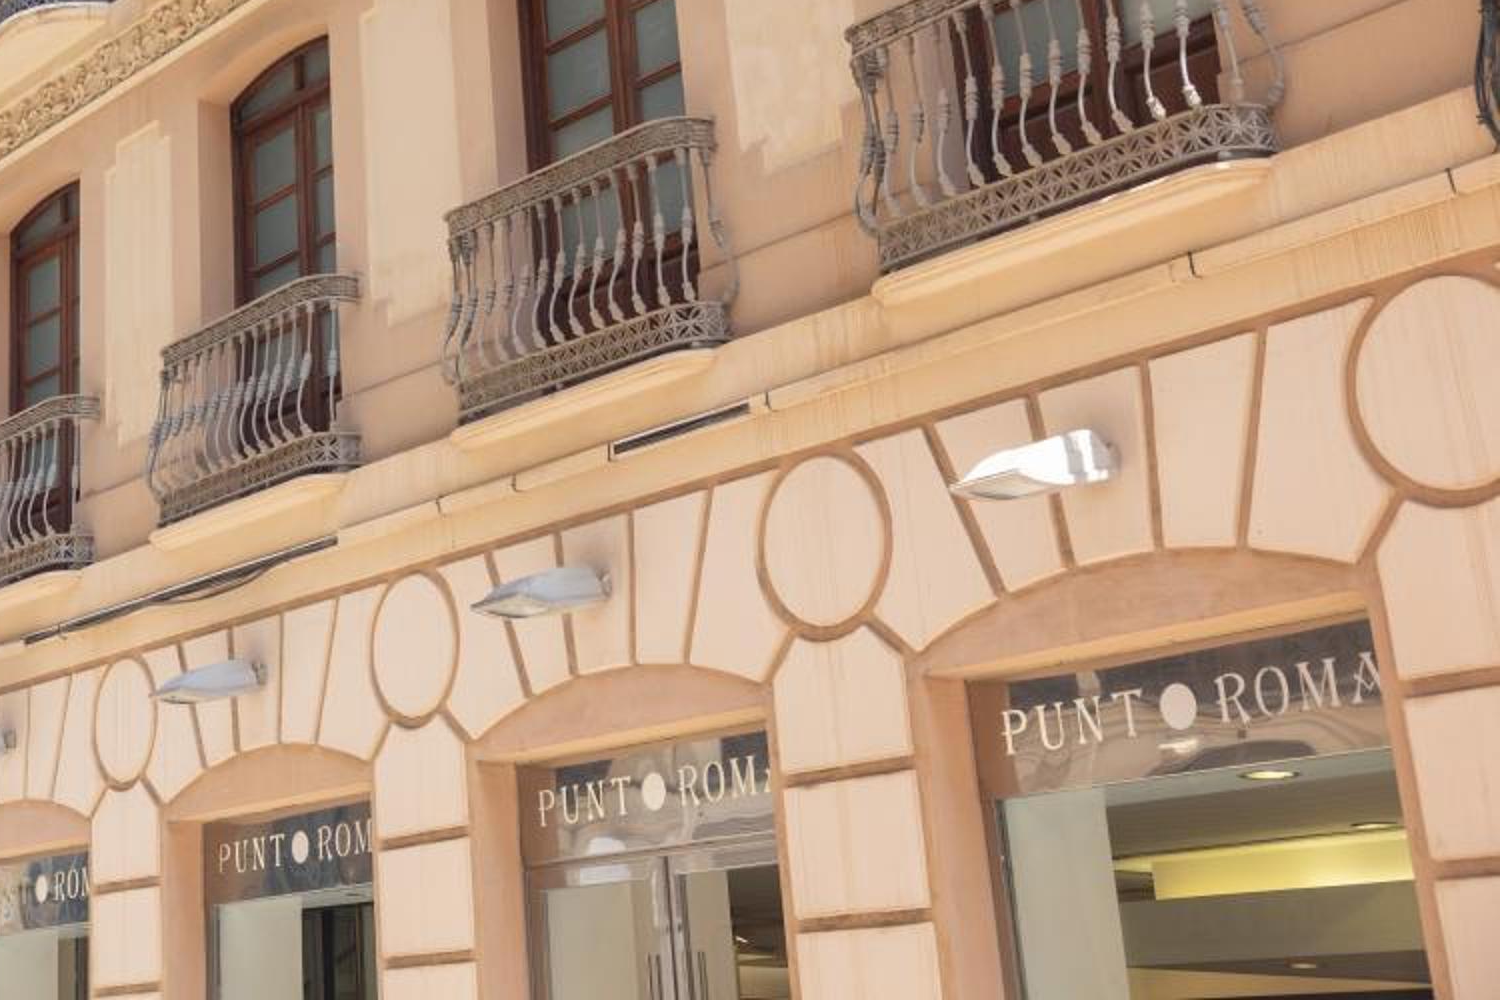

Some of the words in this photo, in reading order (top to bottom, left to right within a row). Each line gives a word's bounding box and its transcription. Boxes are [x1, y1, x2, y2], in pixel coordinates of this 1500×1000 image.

[1214, 651, 1382, 724] ROMA
[677, 755, 772, 806] ROM
[317, 818, 373, 862] ROM
